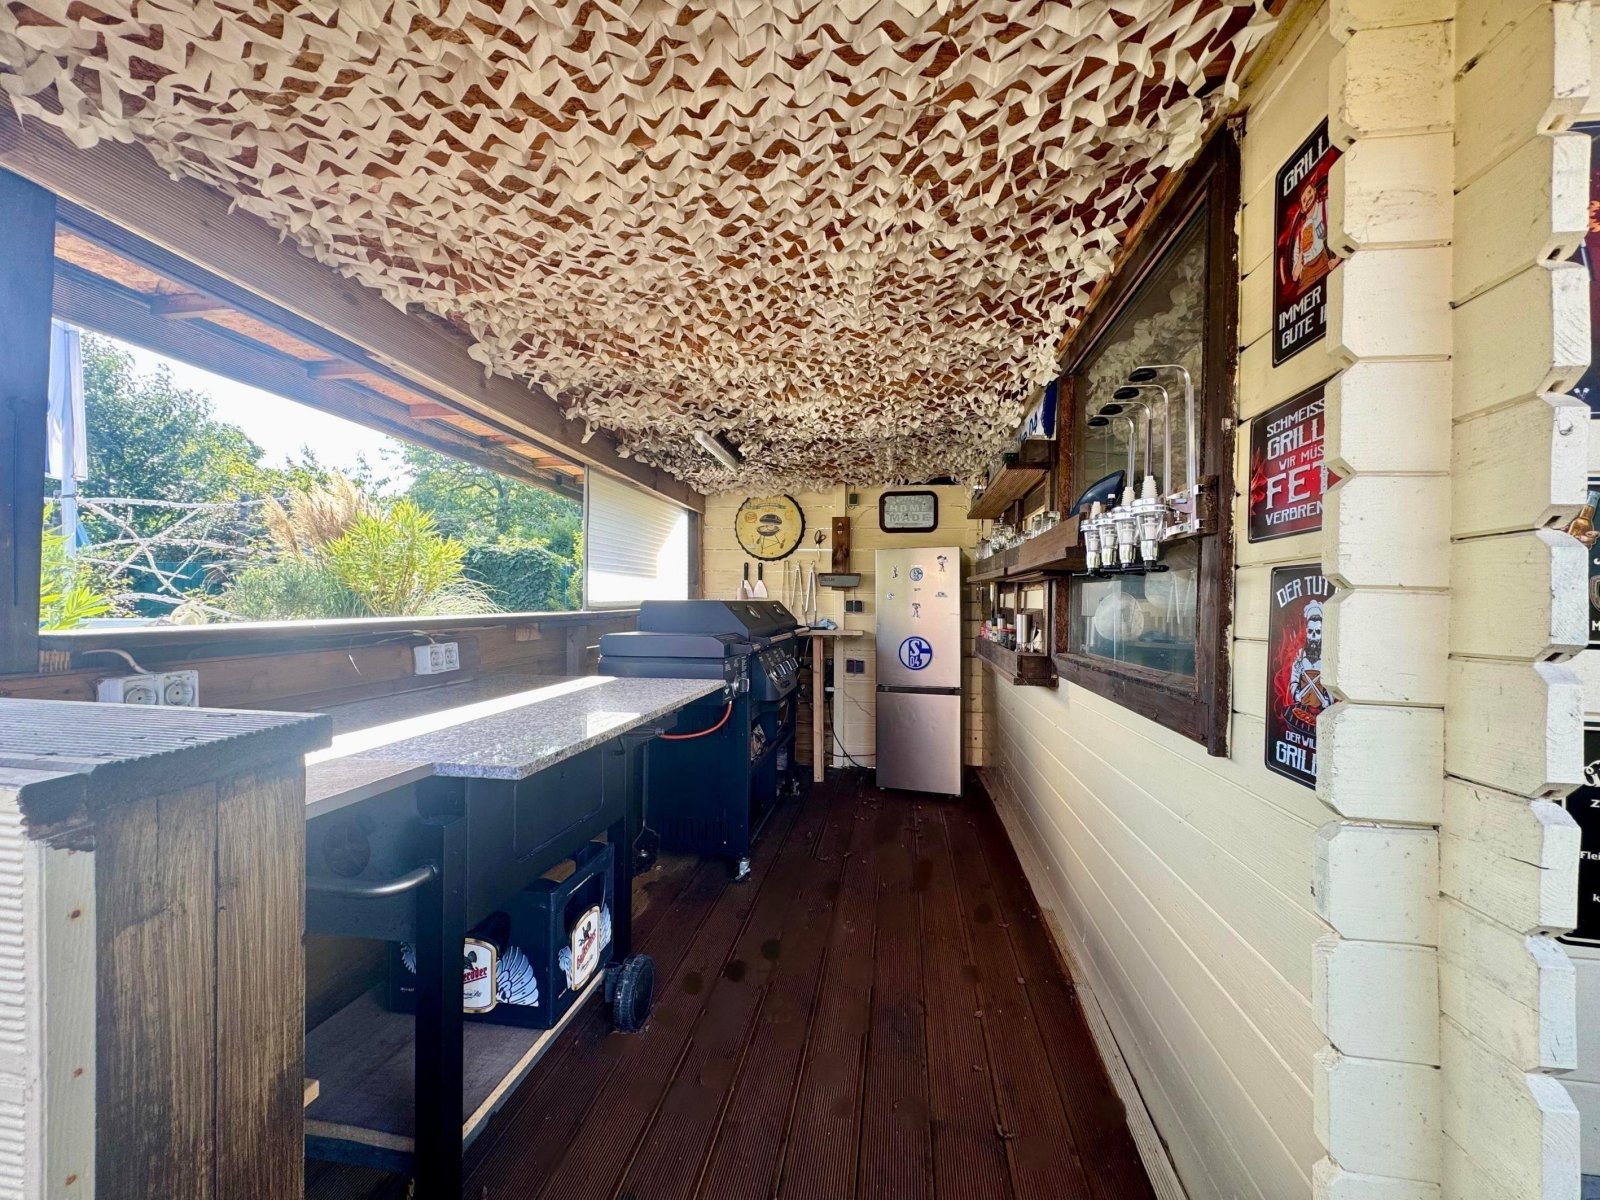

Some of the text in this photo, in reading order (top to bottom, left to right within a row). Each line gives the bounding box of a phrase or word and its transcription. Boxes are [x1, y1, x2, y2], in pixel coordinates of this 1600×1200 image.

[1284, 135, 1331, 196] GRILL
[1279, 286, 1321, 331] IMMER
[1282, 312, 1315, 349] GUTE
[1267, 398, 1325, 437] SCHMEISS
[1267, 418, 1325, 460] GRILL
[1279, 455, 1296, 471] WIR
[889, 512, 932, 522] MADE
[890, 504, 930, 512] HOME
[1276, 578, 1302, 608] DER
[1285, 730, 1301, 745] DER
